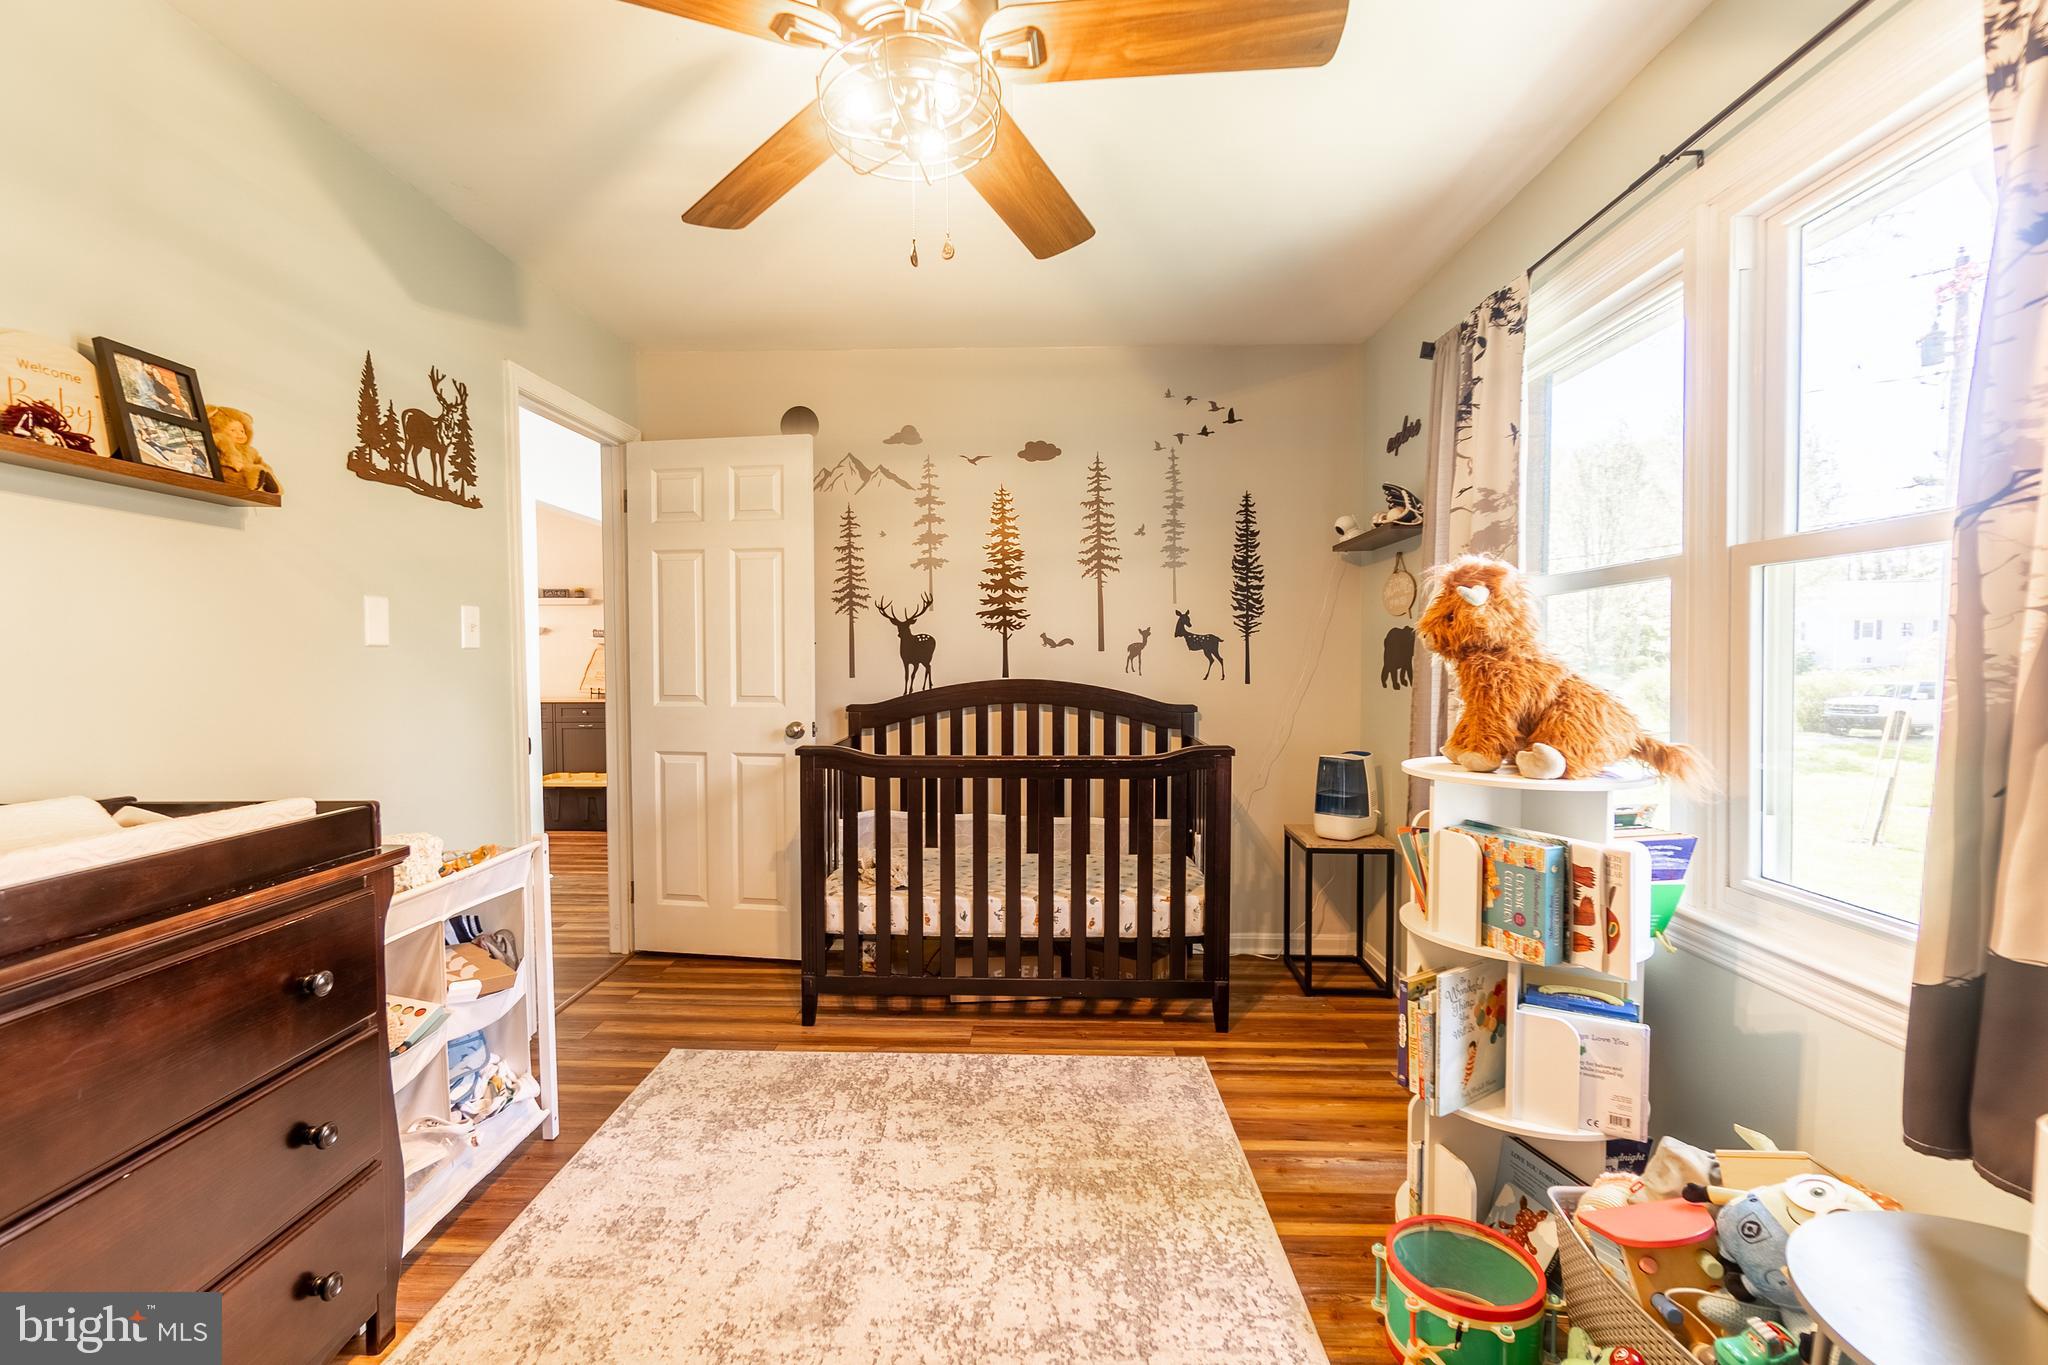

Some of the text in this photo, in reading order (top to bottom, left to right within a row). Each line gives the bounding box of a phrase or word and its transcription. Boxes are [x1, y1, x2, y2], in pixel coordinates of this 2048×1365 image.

[16, 358, 82, 384] Welcome
[1503, 870, 1514, 924] COLLECTION
[1515, 872, 1525, 909] CLASSIC
[1592, 1034, 1611, 1043] Love
[1611, 1037, 1629, 1047] You
